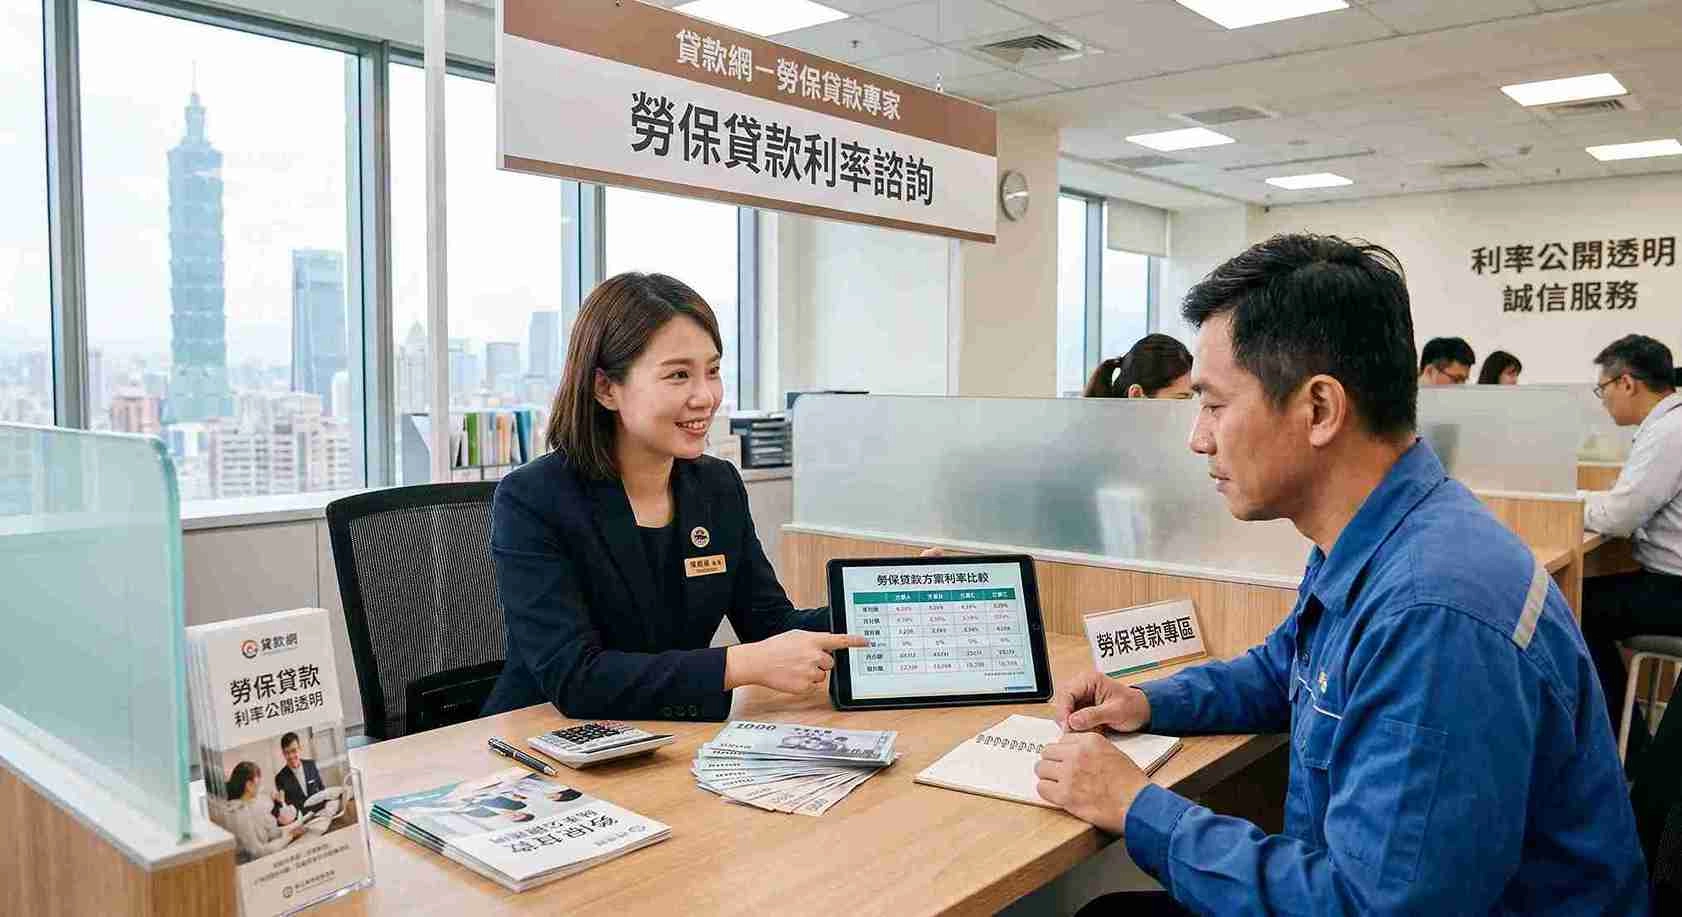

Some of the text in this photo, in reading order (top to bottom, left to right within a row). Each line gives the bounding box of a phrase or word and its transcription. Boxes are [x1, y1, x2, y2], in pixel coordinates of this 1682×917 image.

[631, 91, 934, 206] 勞保貸款利率諮詢
[1471, 236, 1676, 275] 利率公開透明
[1502, 280, 1639, 312] 誠信服務
[1096, 615, 1196, 658] 勞保貸款專區
[229, 664, 321, 705] 勞保貸款
[234, 691, 324, 727] 利率公開透明
